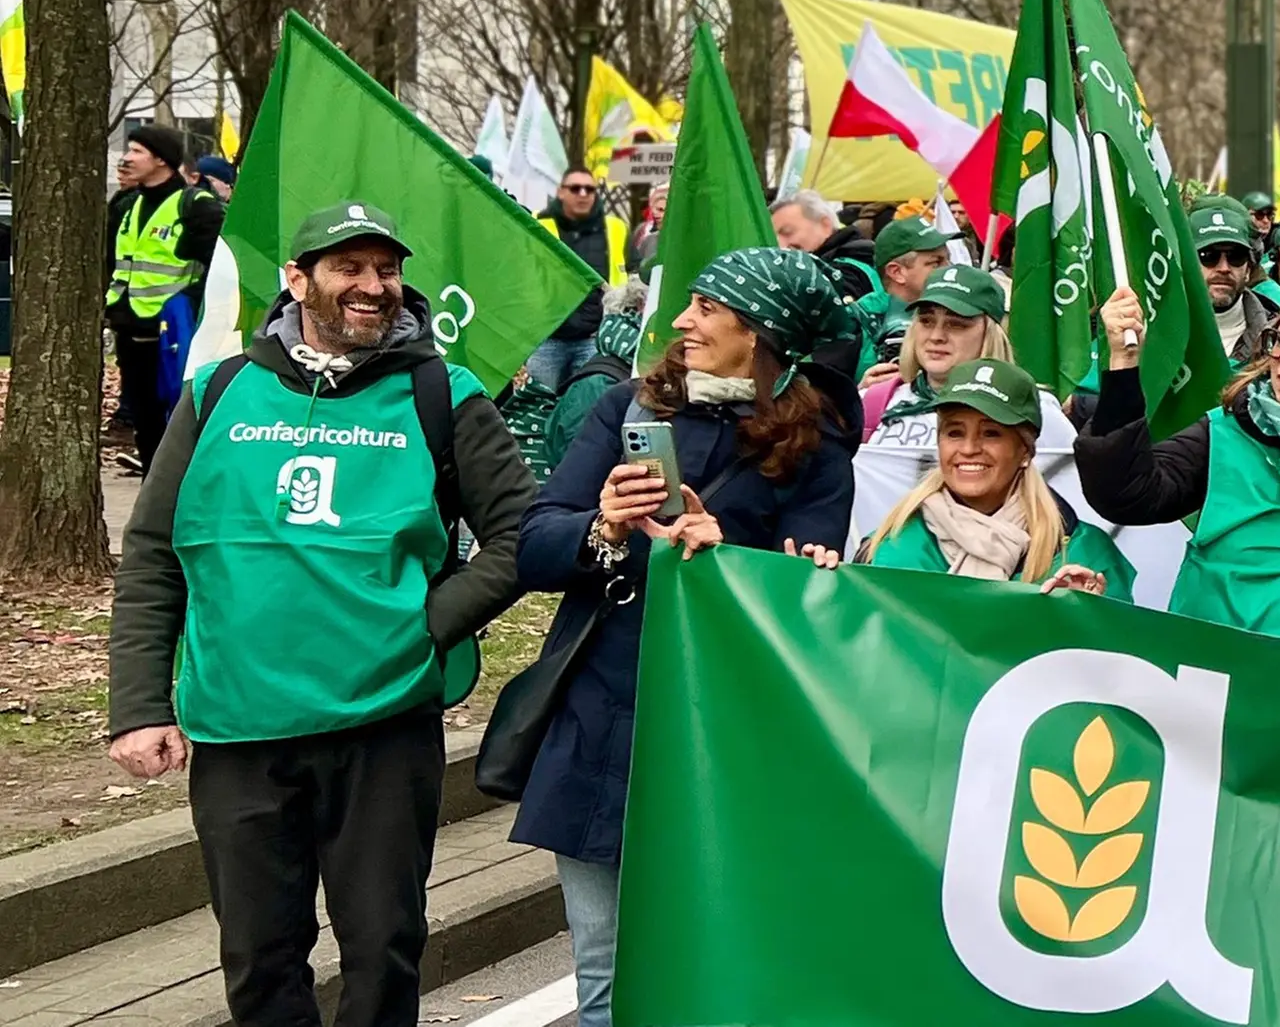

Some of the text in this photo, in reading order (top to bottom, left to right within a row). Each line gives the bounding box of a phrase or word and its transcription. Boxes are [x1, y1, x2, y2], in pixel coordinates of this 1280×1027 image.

[648, 152, 673, 163] FEED
[630, 165, 674, 176] RESPECT
[228, 421, 407, 451] Confagricoltura
